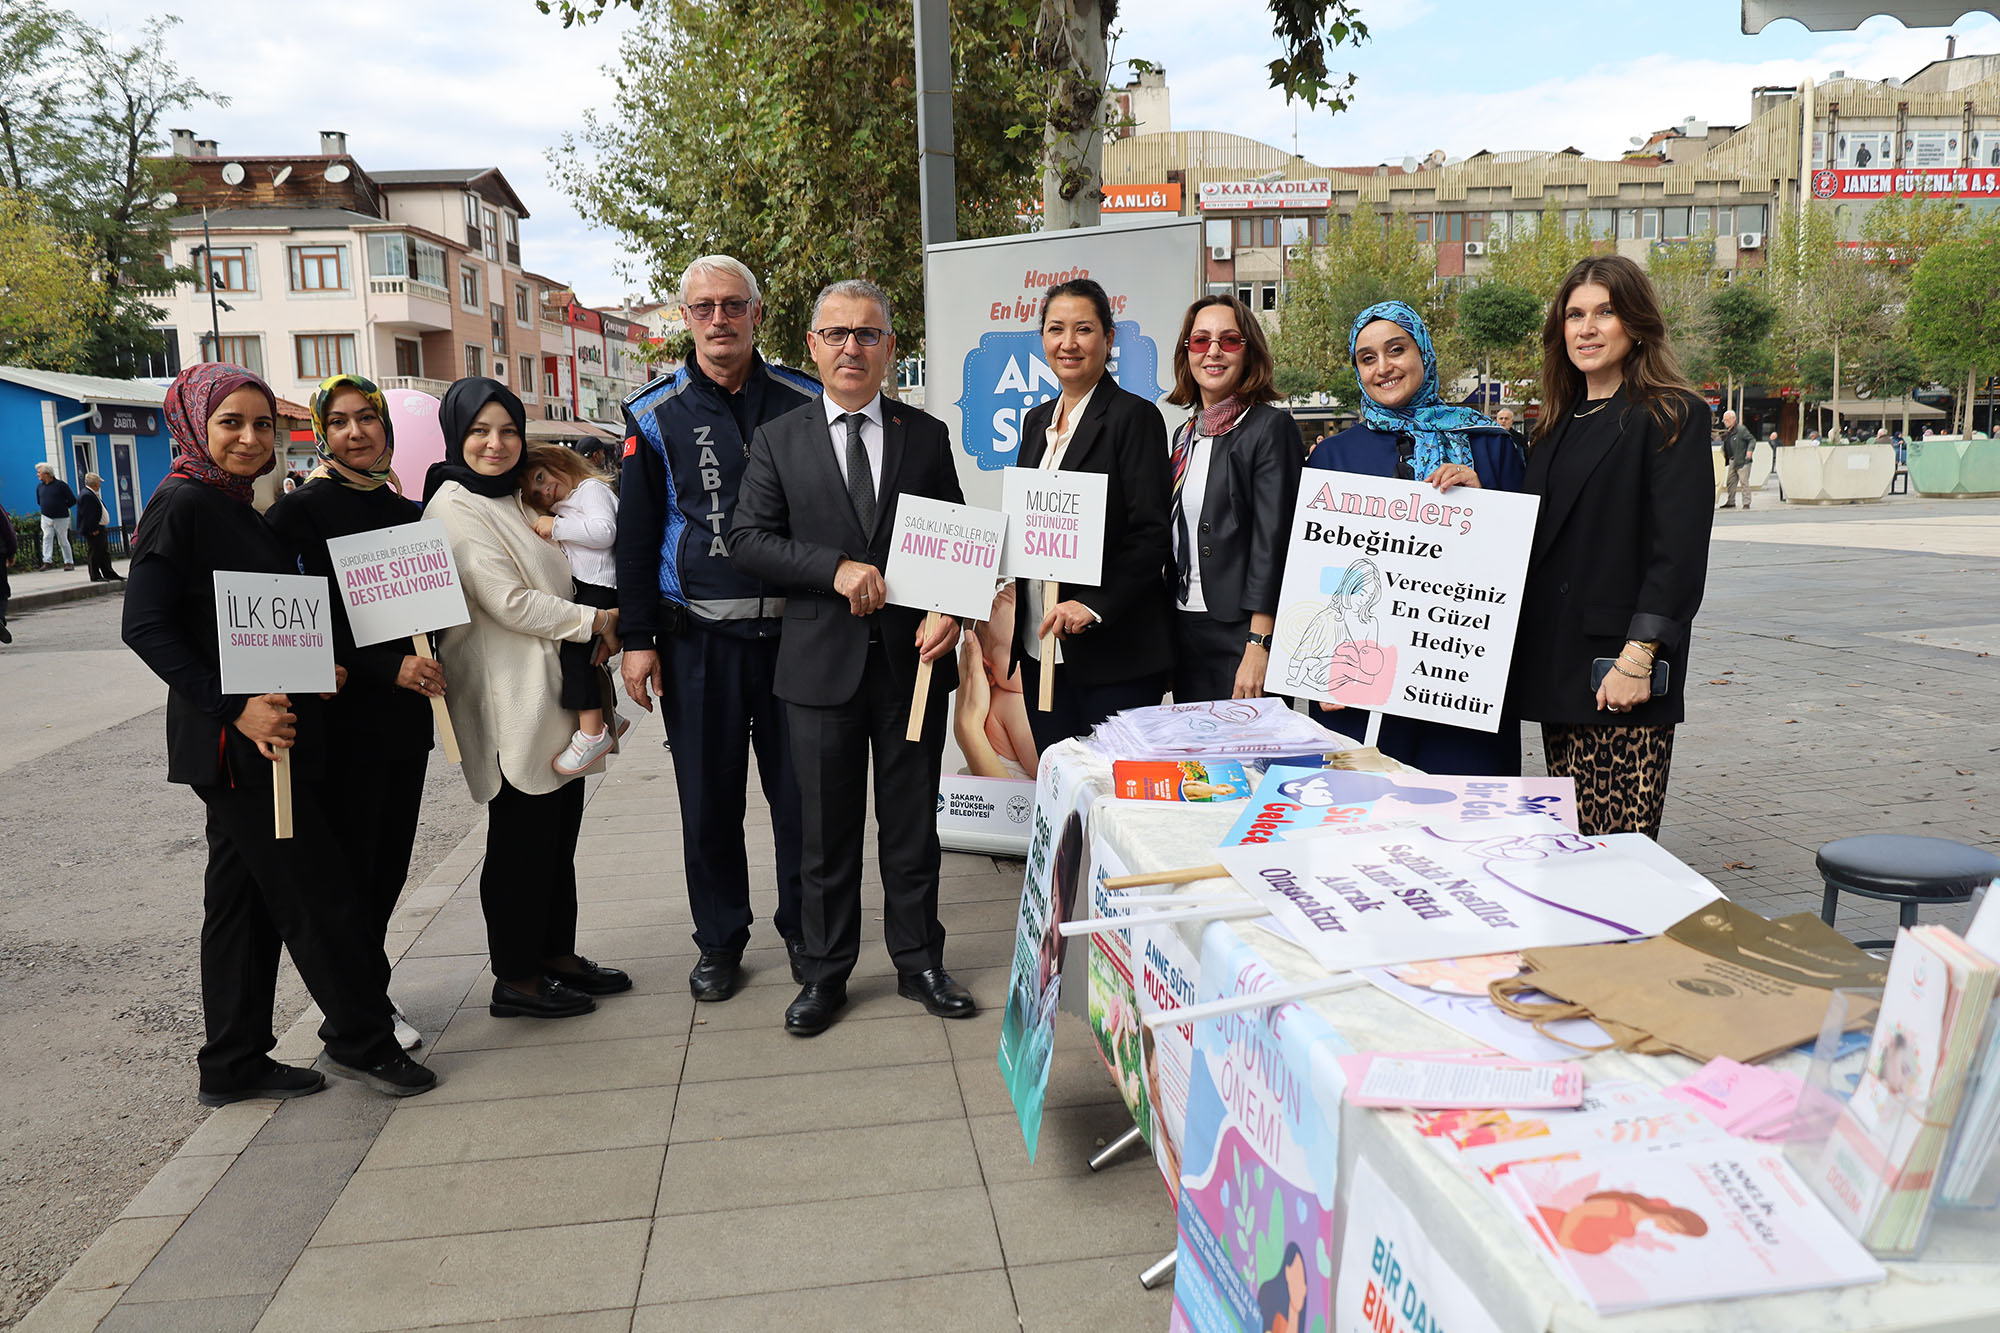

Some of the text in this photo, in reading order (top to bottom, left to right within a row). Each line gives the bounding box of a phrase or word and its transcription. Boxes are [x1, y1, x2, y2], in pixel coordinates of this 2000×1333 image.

[1221, 182, 1329, 194] KARAKADILAR
[1842, 170, 2000, 194] JANEM GÜVENLİK A.Ş.
[990, 302, 1011, 321] En
[1014, 296, 1037, 323] İyi
[113, 417, 137, 429] ZABITA
[693, 425, 730, 558] ZABITA
[1026, 489, 1081, 515] MUCİZE
[1025, 514, 1079, 531] SÜTÜNÜZDE
[1306, 481, 1474, 536] Anneler;
[904, 515, 999, 544] SAĞLIKLI NESİLLER İÇİN
[1024, 530, 1078, 559] SAKLI
[1302, 520, 1443, 559] Bebeğinize
[340, 538, 444, 568] SÜRDÜRÜLEBİLİR GELECEK İÇİN
[900, 532, 995, 568] ANNE SÜTÜ
[346, 548, 448, 589] ANNE SÜTÜNÜ
[349, 570, 454, 607] DESTEKLİYORUZ
[1385, 571, 1508, 605] Vereceğiniz
[227, 589, 265, 629] İLK
[1390, 599, 1491, 631] En Güzel
[231, 631, 324, 648] SADECE ANNE SÜTÜ
[1410, 631, 1486, 660] Hediye
[1412, 660, 1470, 683] Anne
[1403, 685, 1494, 716] Sütüdür
[950, 793, 984, 802] SAKARYA
[950, 800, 995, 811] BÜYÜKŞEHİR
[950, 809, 990, 818] BELEDİYESİ
[1036, 804, 1052, 850] Doğal
[1238, 802, 1303, 846] Gelece
[1031, 836, 1046, 876] Olan
[1026, 863, 1048, 920] Normal
[1391, 887, 1453, 920] Sütü
[1436, 878, 1520, 929] Nesiller
[1145, 939, 1169, 981] ANNE
[1170, 965, 1195, 1006] SÜTÜ
[1221, 1052, 1282, 1164] ÖNEMİ
[1372, 1235, 1402, 1300] BİR
